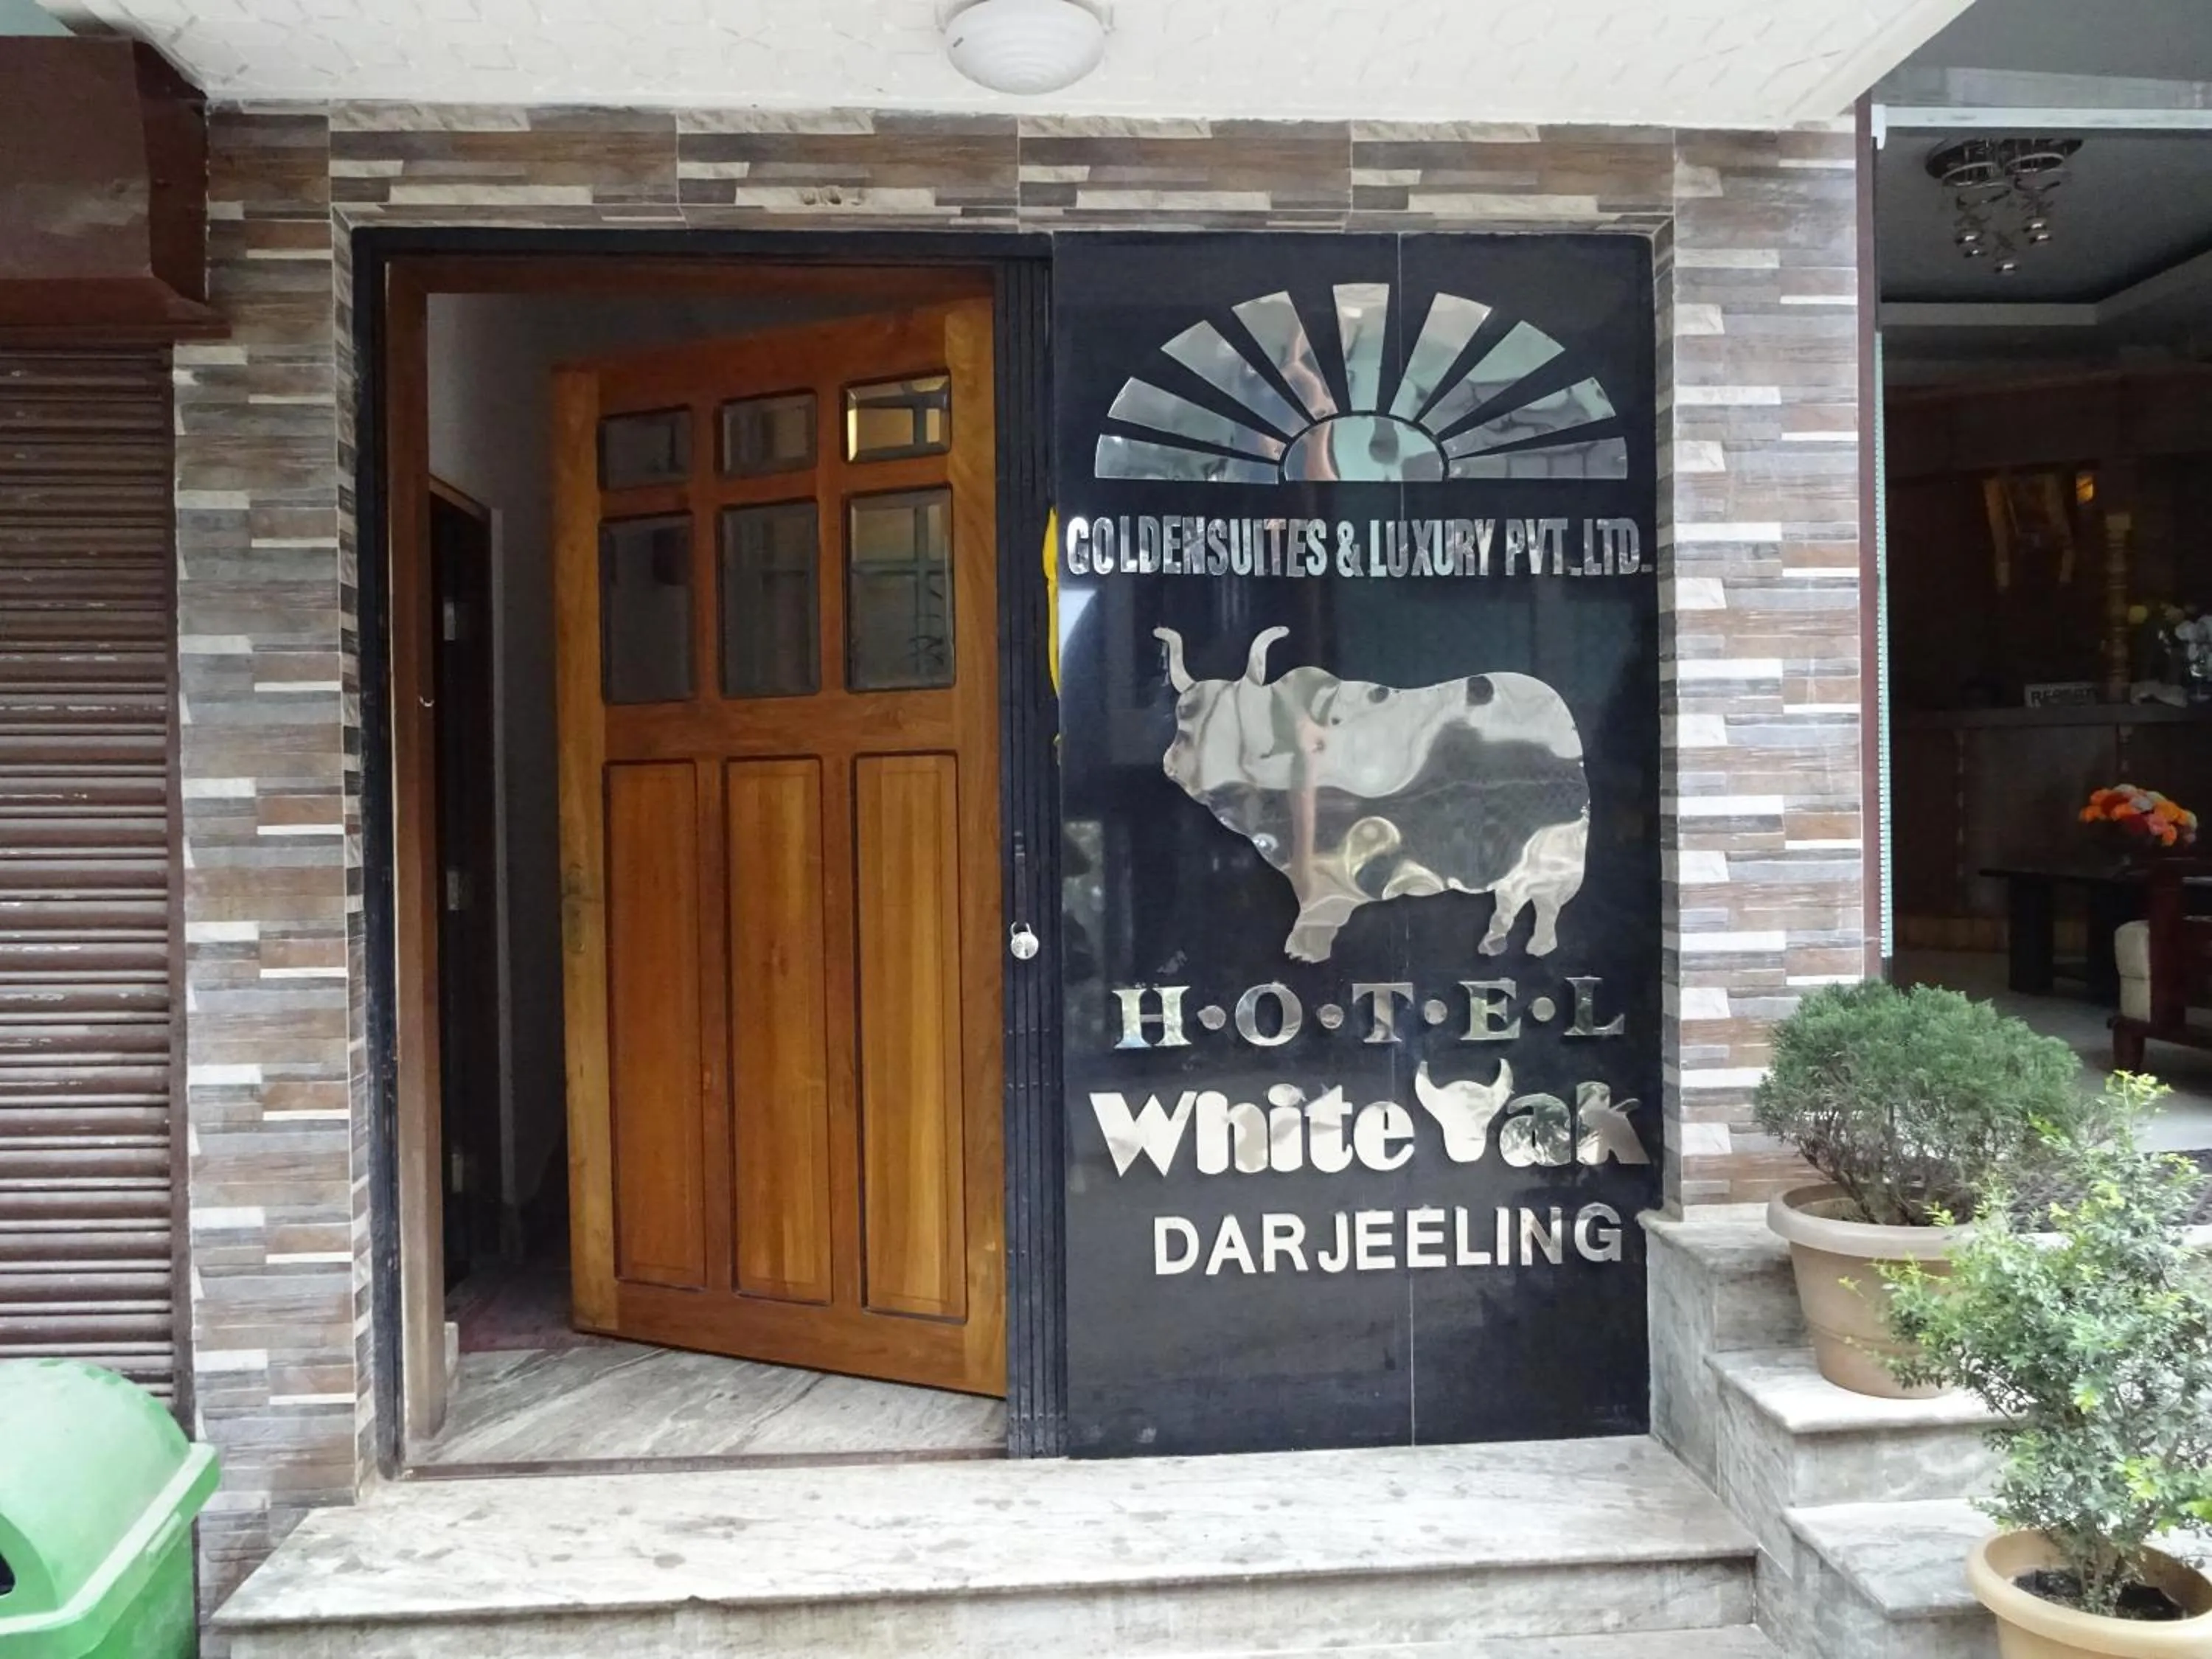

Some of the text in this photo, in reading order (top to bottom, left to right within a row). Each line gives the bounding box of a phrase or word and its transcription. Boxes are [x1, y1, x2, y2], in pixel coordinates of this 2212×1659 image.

[1335, 520, 1364, 577] &
[1369, 518, 1496, 577] LUXURY
[1153, 1201, 1623, 1276] DARJEELING
